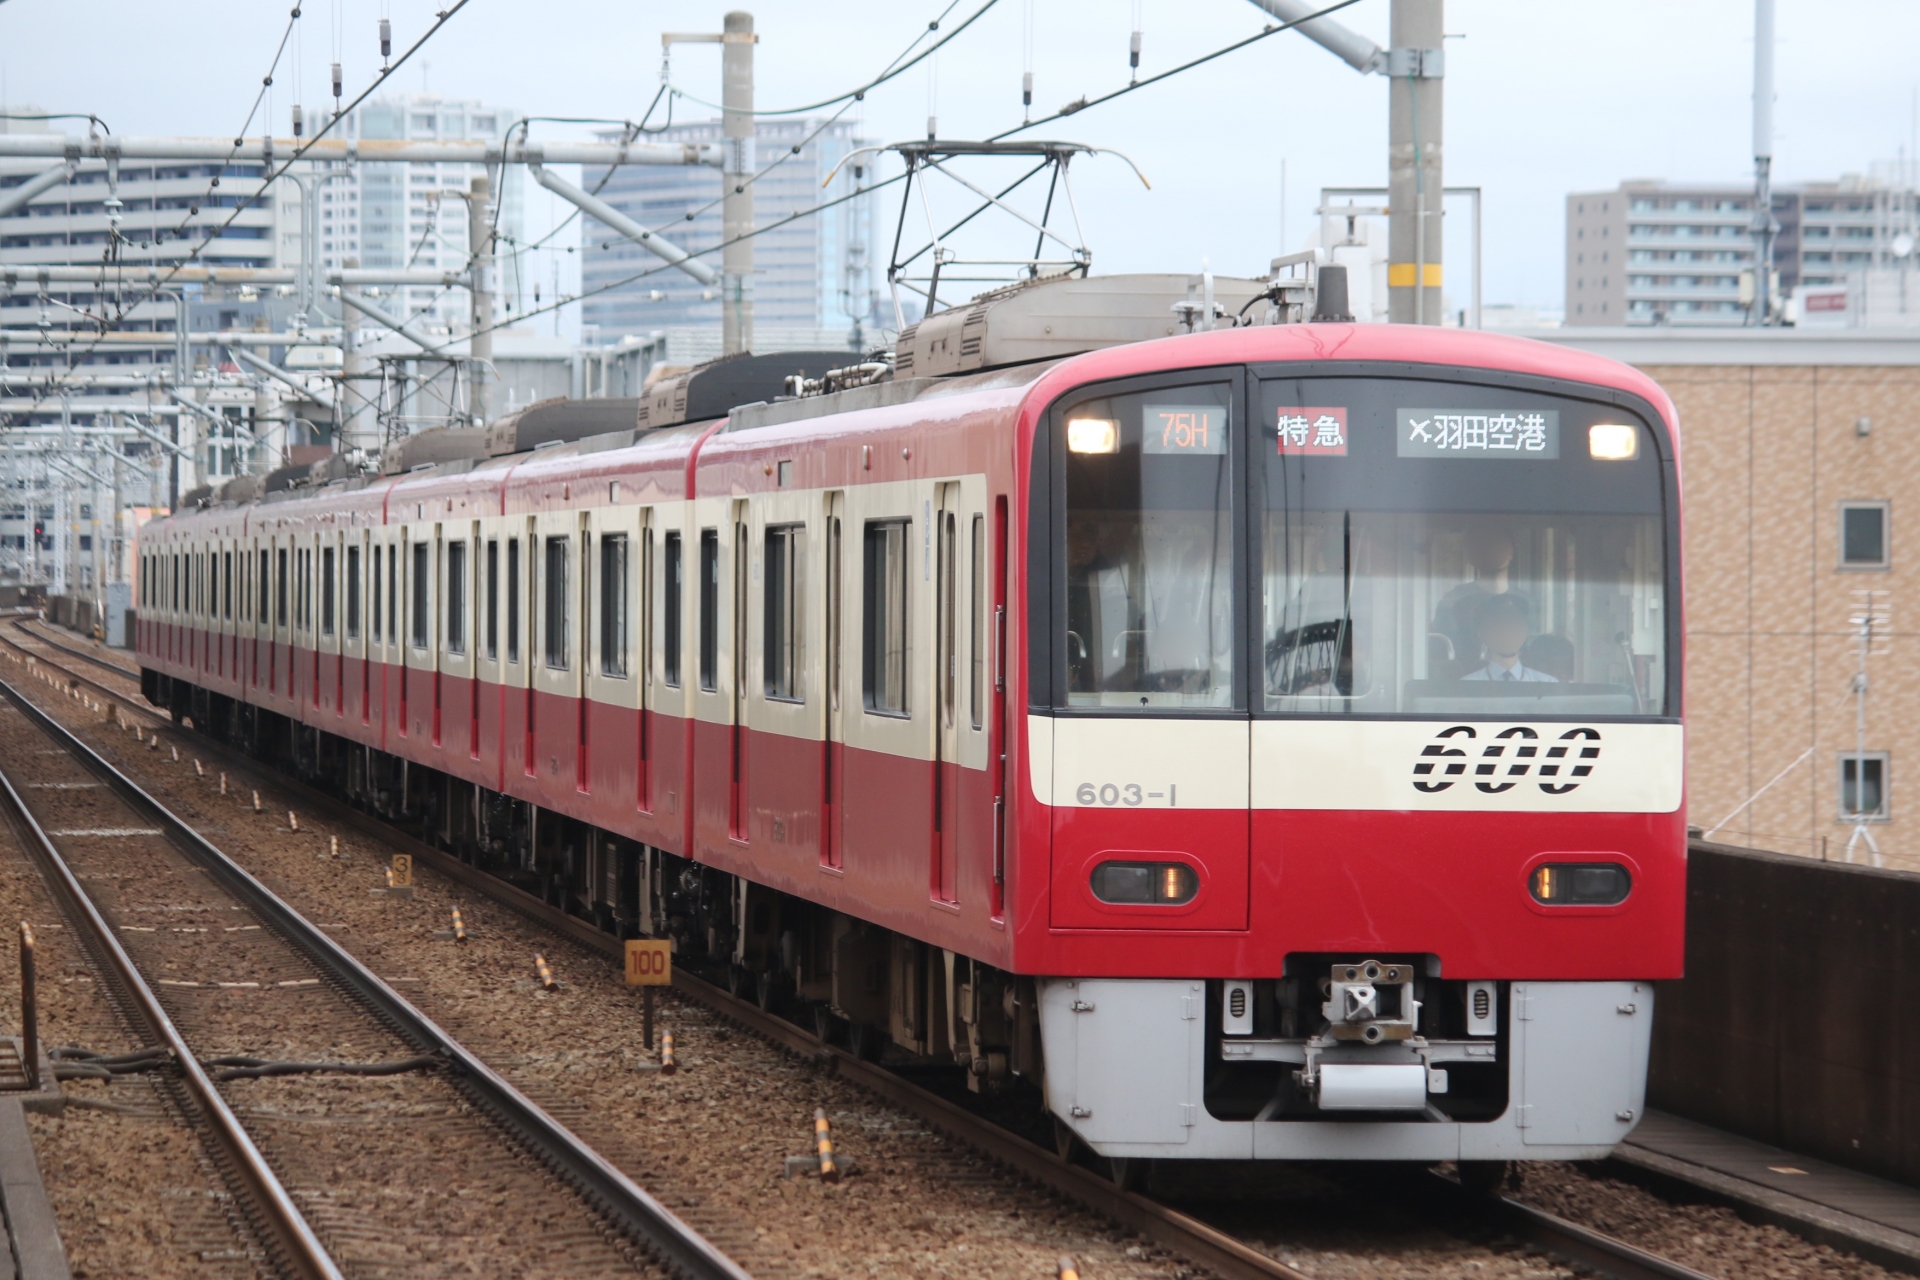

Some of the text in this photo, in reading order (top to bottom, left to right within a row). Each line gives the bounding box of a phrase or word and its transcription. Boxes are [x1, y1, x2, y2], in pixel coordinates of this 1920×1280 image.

[1159, 413, 1207, 447] 75H
[1277, 414, 1344, 447] 特急
[1433, 413, 1546, 451] 羽田空港
[1412, 726, 1602, 795] 600
[1076, 782, 1176, 807] 603-1
[395, 856, 408, 873] 3
[631, 950, 664, 976] 100
